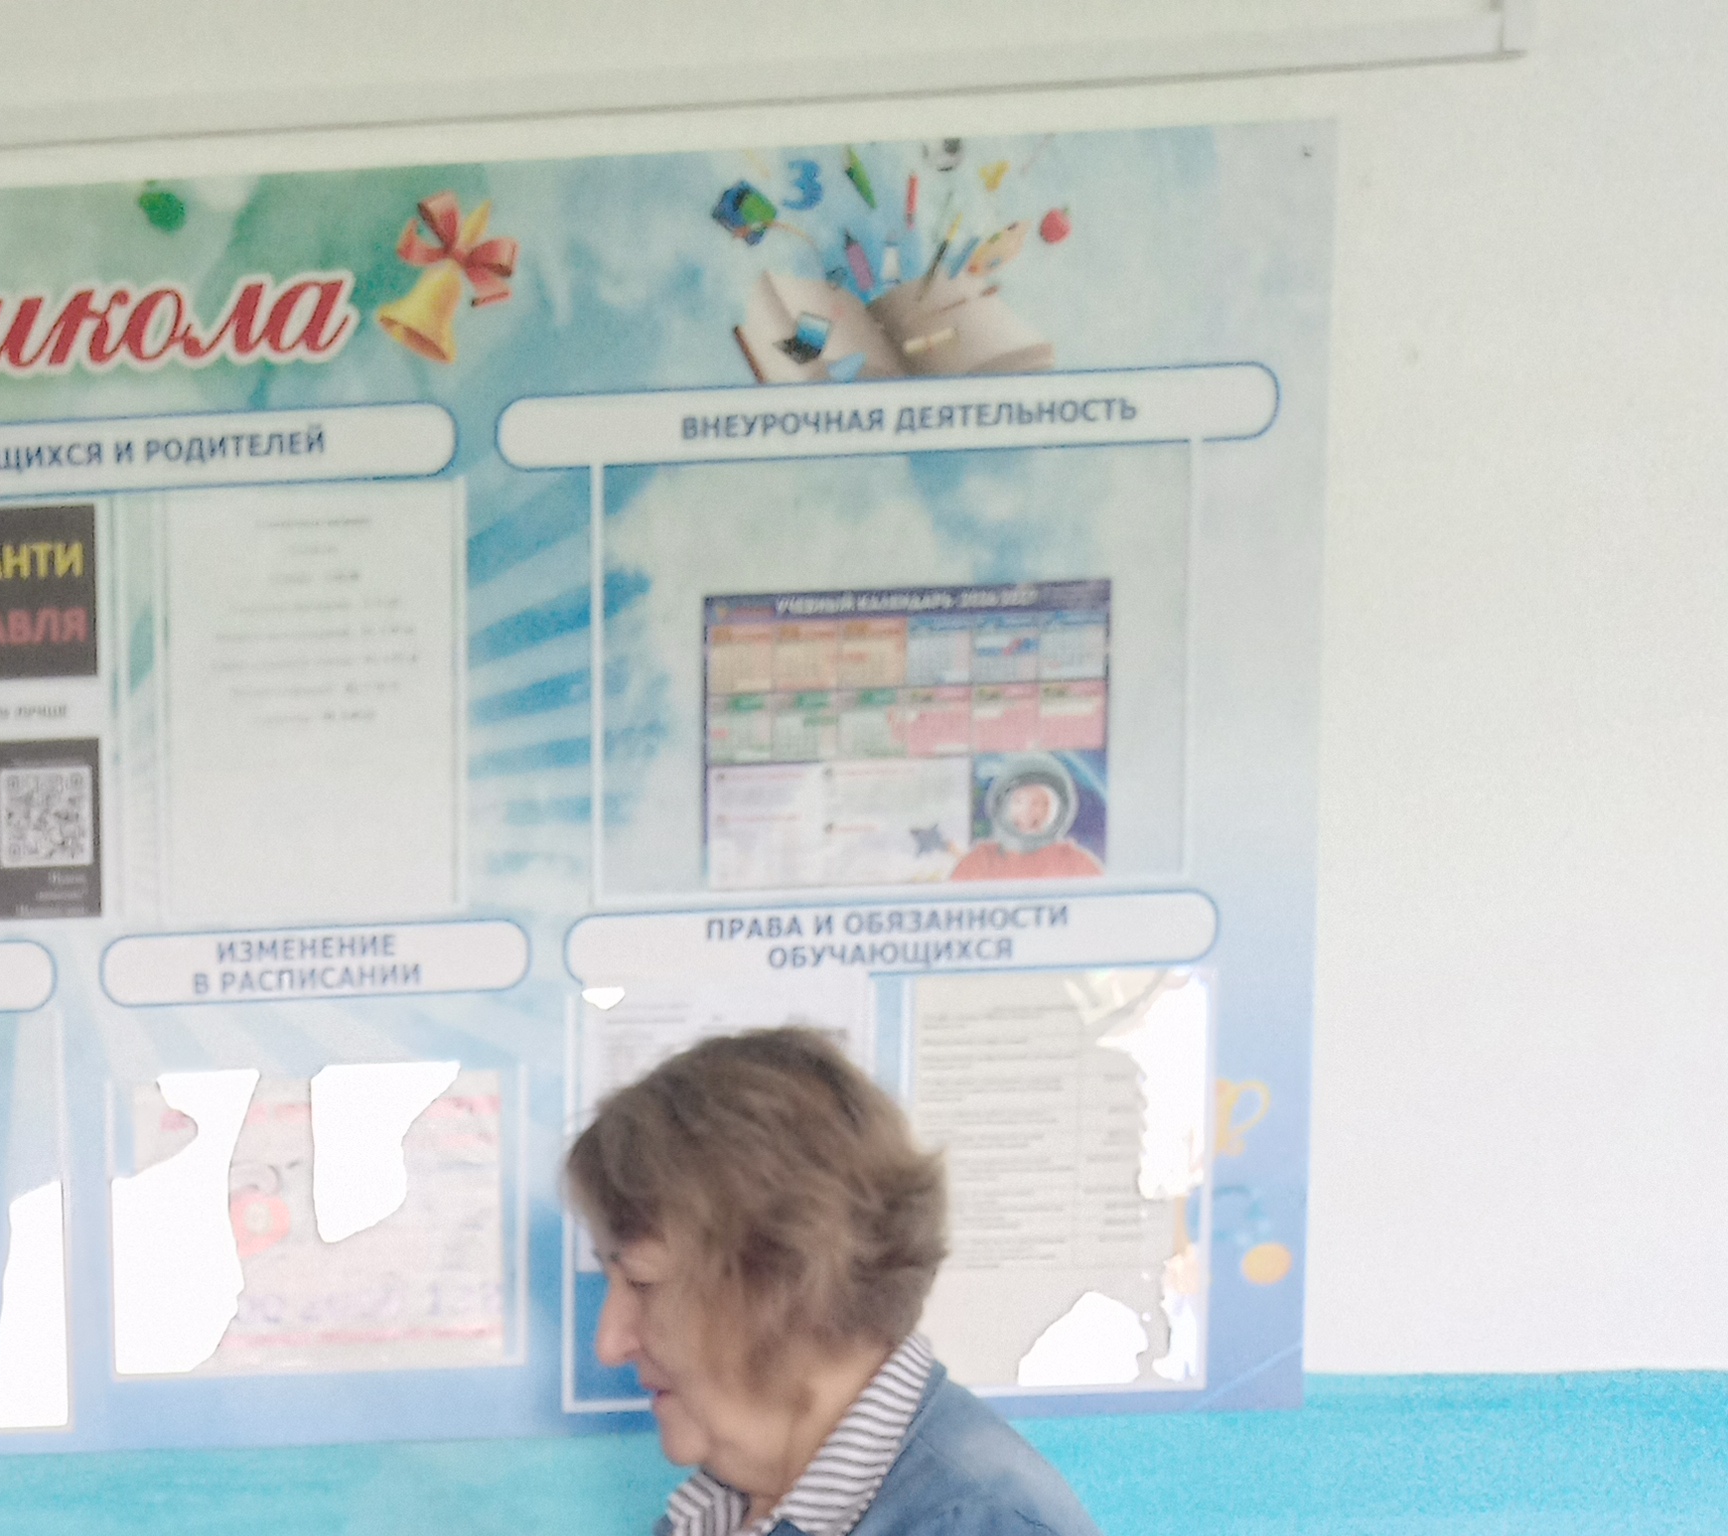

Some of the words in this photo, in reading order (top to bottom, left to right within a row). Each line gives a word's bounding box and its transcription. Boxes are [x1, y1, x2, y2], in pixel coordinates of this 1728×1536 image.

[680, 408, 885, 441] ВНЕУРОЧНАЯ
[894, 398, 1138, 434] ДЕЯТЕЛЬНОСТЬ
[114, 440, 134, 464] И
[144, 424, 326, 464] РОДИТЕЛЕЙ
[705, 914, 804, 940] ПРАВА
[815, 913, 833, 936] И
[843, 904, 1069, 936] ОБЯЗАННОСТИ
[216, 933, 396, 963] ИЗМЕНЕНИЕ
[768, 937, 1014, 970] ОБУЧАЮЩИХСЯ
[193, 972, 210, 995] В
[221, 962, 422, 994] РАСПИСАНИИ
